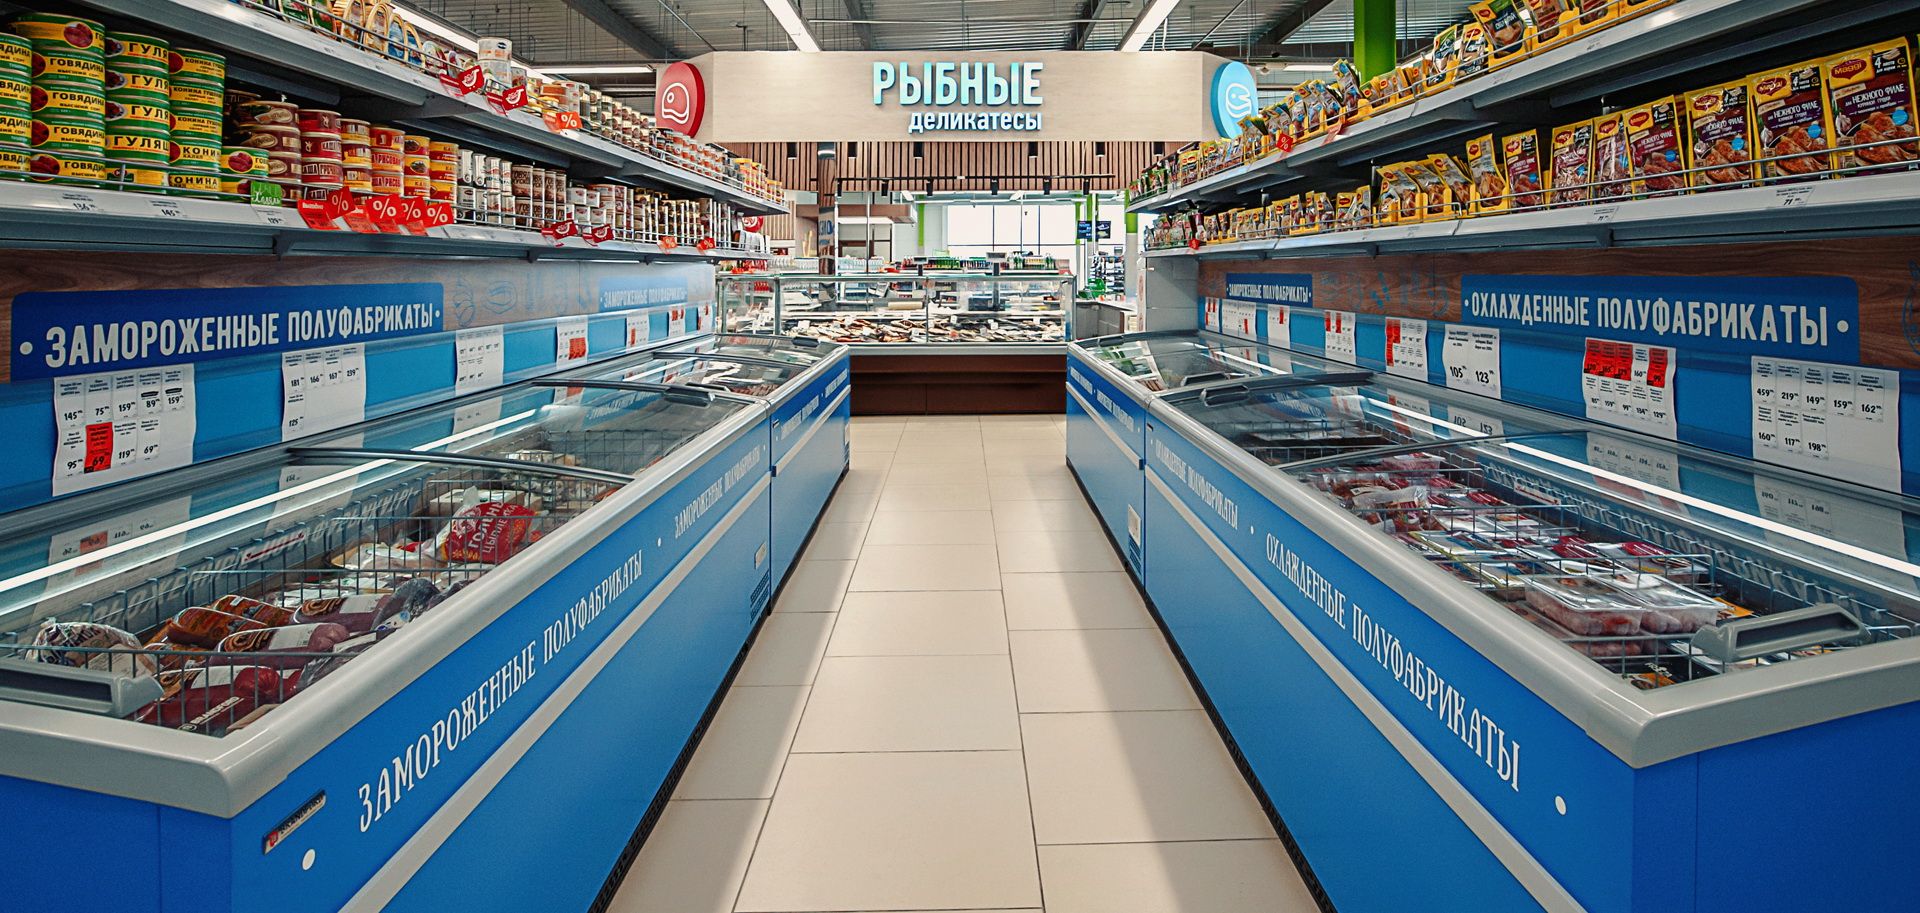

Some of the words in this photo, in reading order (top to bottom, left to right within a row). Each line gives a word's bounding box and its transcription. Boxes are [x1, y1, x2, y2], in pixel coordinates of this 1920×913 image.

[1834, 63, 1862, 74] Maggi
[173, 87, 202, 95] КОНИНА
[873, 61, 1043, 106] РЫБНЫЕ
[1852, 89, 1884, 104] НЕЖНОГО
[1885, 83, 1905, 95] ФИЛЕ
[177, 116, 205, 125] КОНИНА
[560, 113, 578, 128] %
[908, 110, 1042, 134] деликатесы
[1280, 135, 1289, 150] %
[372, 198, 397, 220] %
[426, 206, 448, 225] %
[1471, 291, 1589, 326] ОХЛАЖДЕННЫЕ
[1597, 297, 1828, 347] ПОЛУФАБРИКАТЫ
[45, 312, 279, 368] ЗАМОРОЖЕННЫЕ
[288, 302, 433, 342] ПОЛУФАБРИКАТЫ
[1155, 439, 1186, 483] ОХЛАЖДЕННЫЕ
[1188, 466, 1238, 530] ПОЛУФАБРИКАТЫ
[674, 482, 722, 539] ЗАМОРОЖЕННЫЕ
[482, 504, 517, 553] ЦЫПЛЕКА
[1266, 532, 1346, 630] ОХЛАЖДЕННЫЕ
[1352, 602, 1520, 792] ПОЛУФАБРИКАТЫ
[357, 639, 536, 833] ЗАМОРОЖЕННЫЕ
[543, 549, 642, 665] ПОЛУФАБРИКАТЫ
